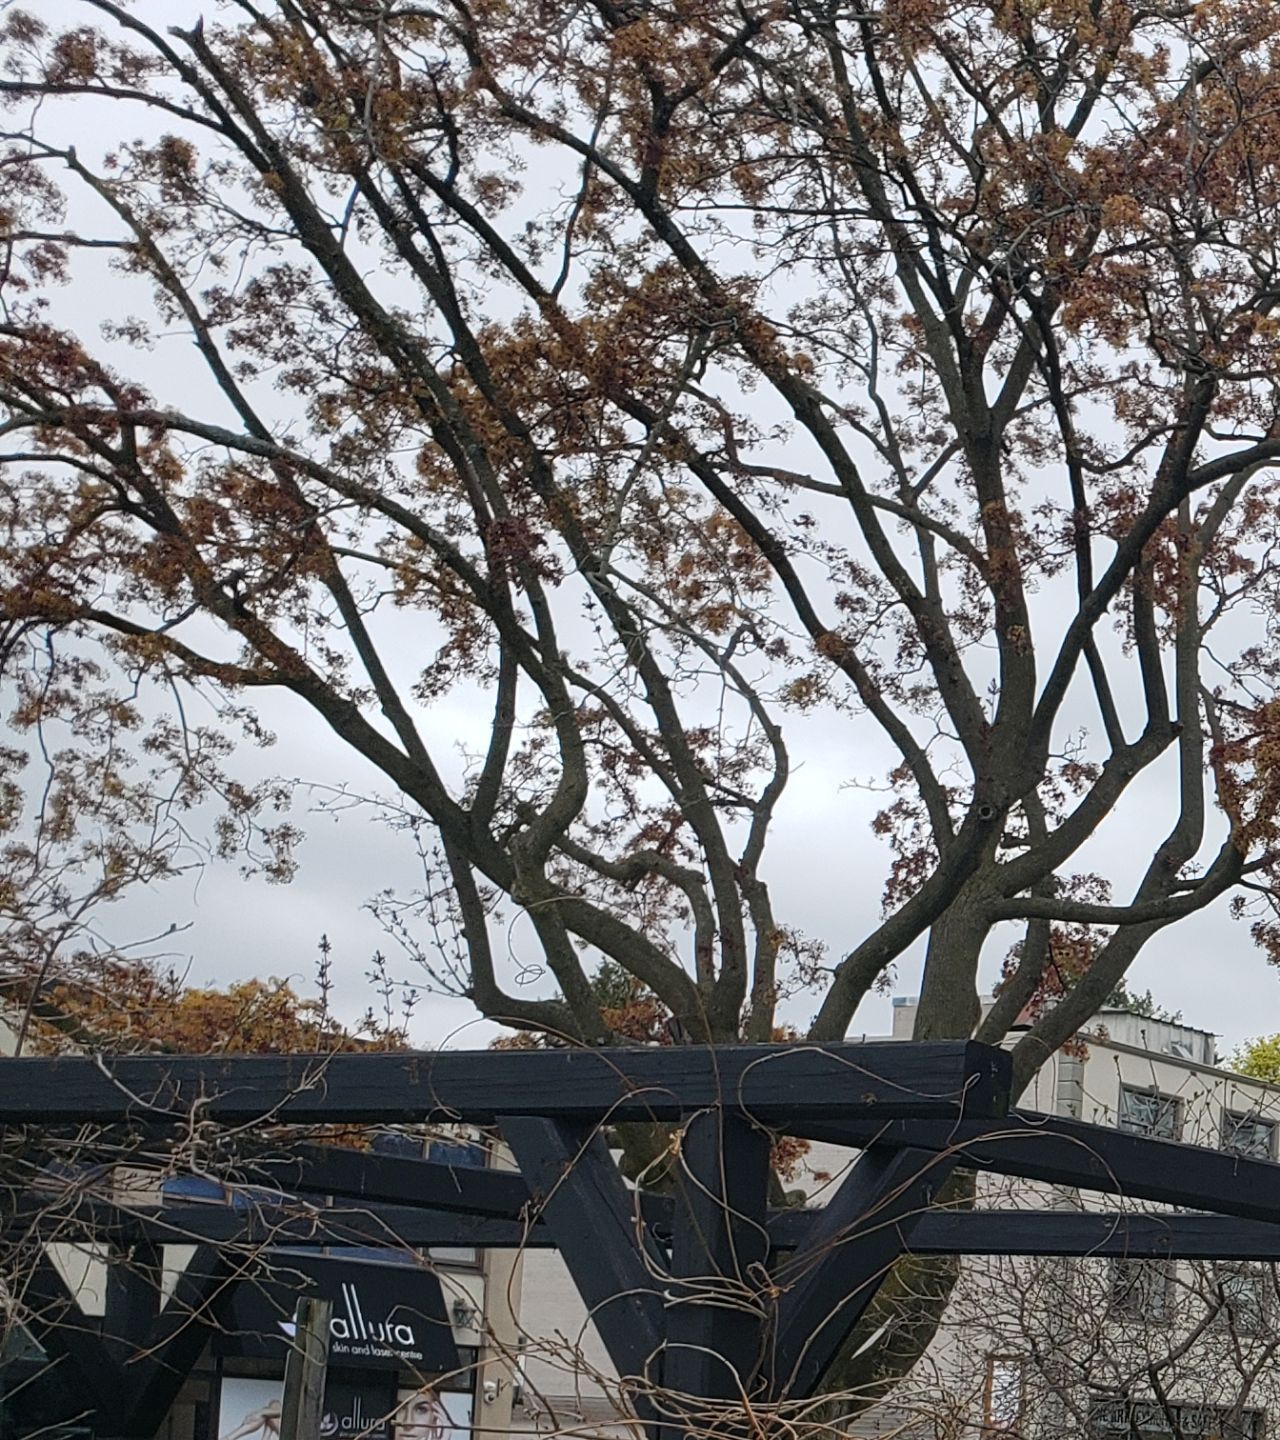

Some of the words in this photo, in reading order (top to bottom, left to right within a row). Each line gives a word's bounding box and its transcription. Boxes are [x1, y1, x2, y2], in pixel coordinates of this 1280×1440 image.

[329, 1283, 415, 1345] allura
[332, 1341, 350, 1353] skin
[351, 1344, 370, 1356] and
[341, 1396, 386, 1430] allura
